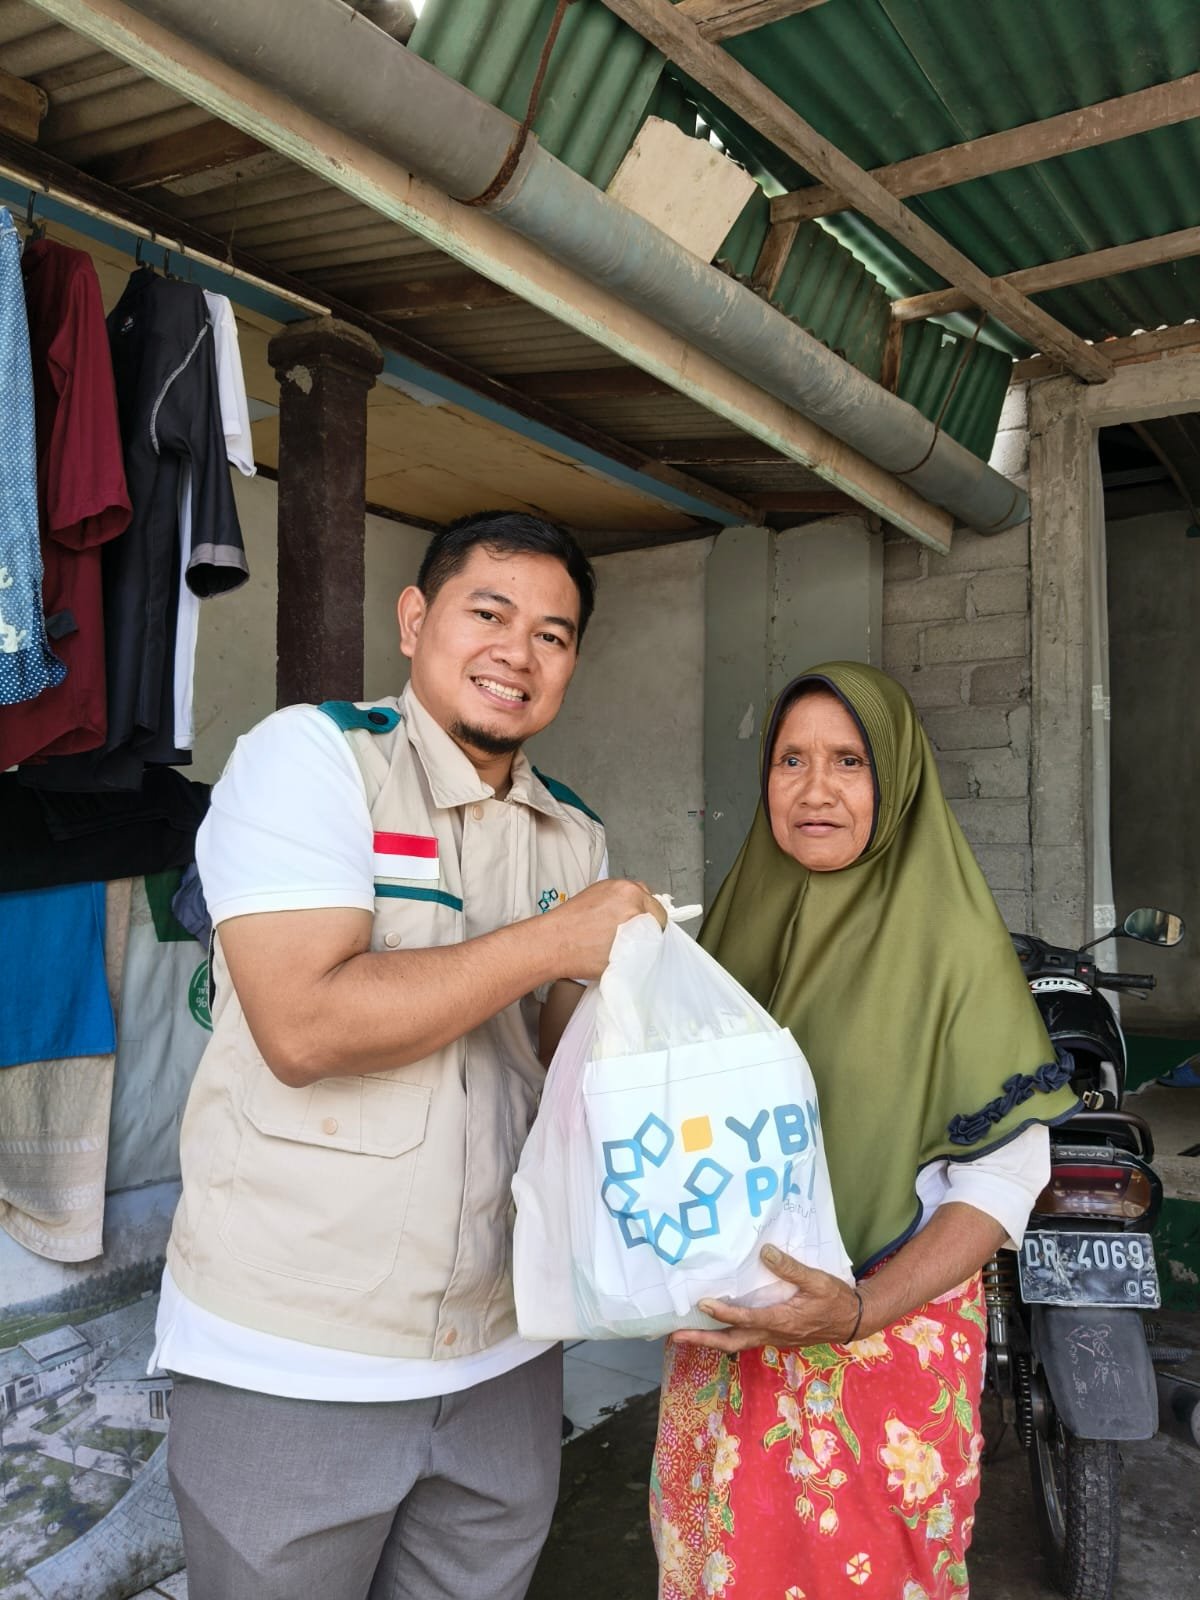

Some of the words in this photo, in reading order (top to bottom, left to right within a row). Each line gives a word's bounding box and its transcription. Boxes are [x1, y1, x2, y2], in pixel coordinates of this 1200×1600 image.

[1024, 1238, 1059, 1268] DR
[1077, 1239, 1145, 1271] 4069
[1125, 1280, 1157, 1298] 05
